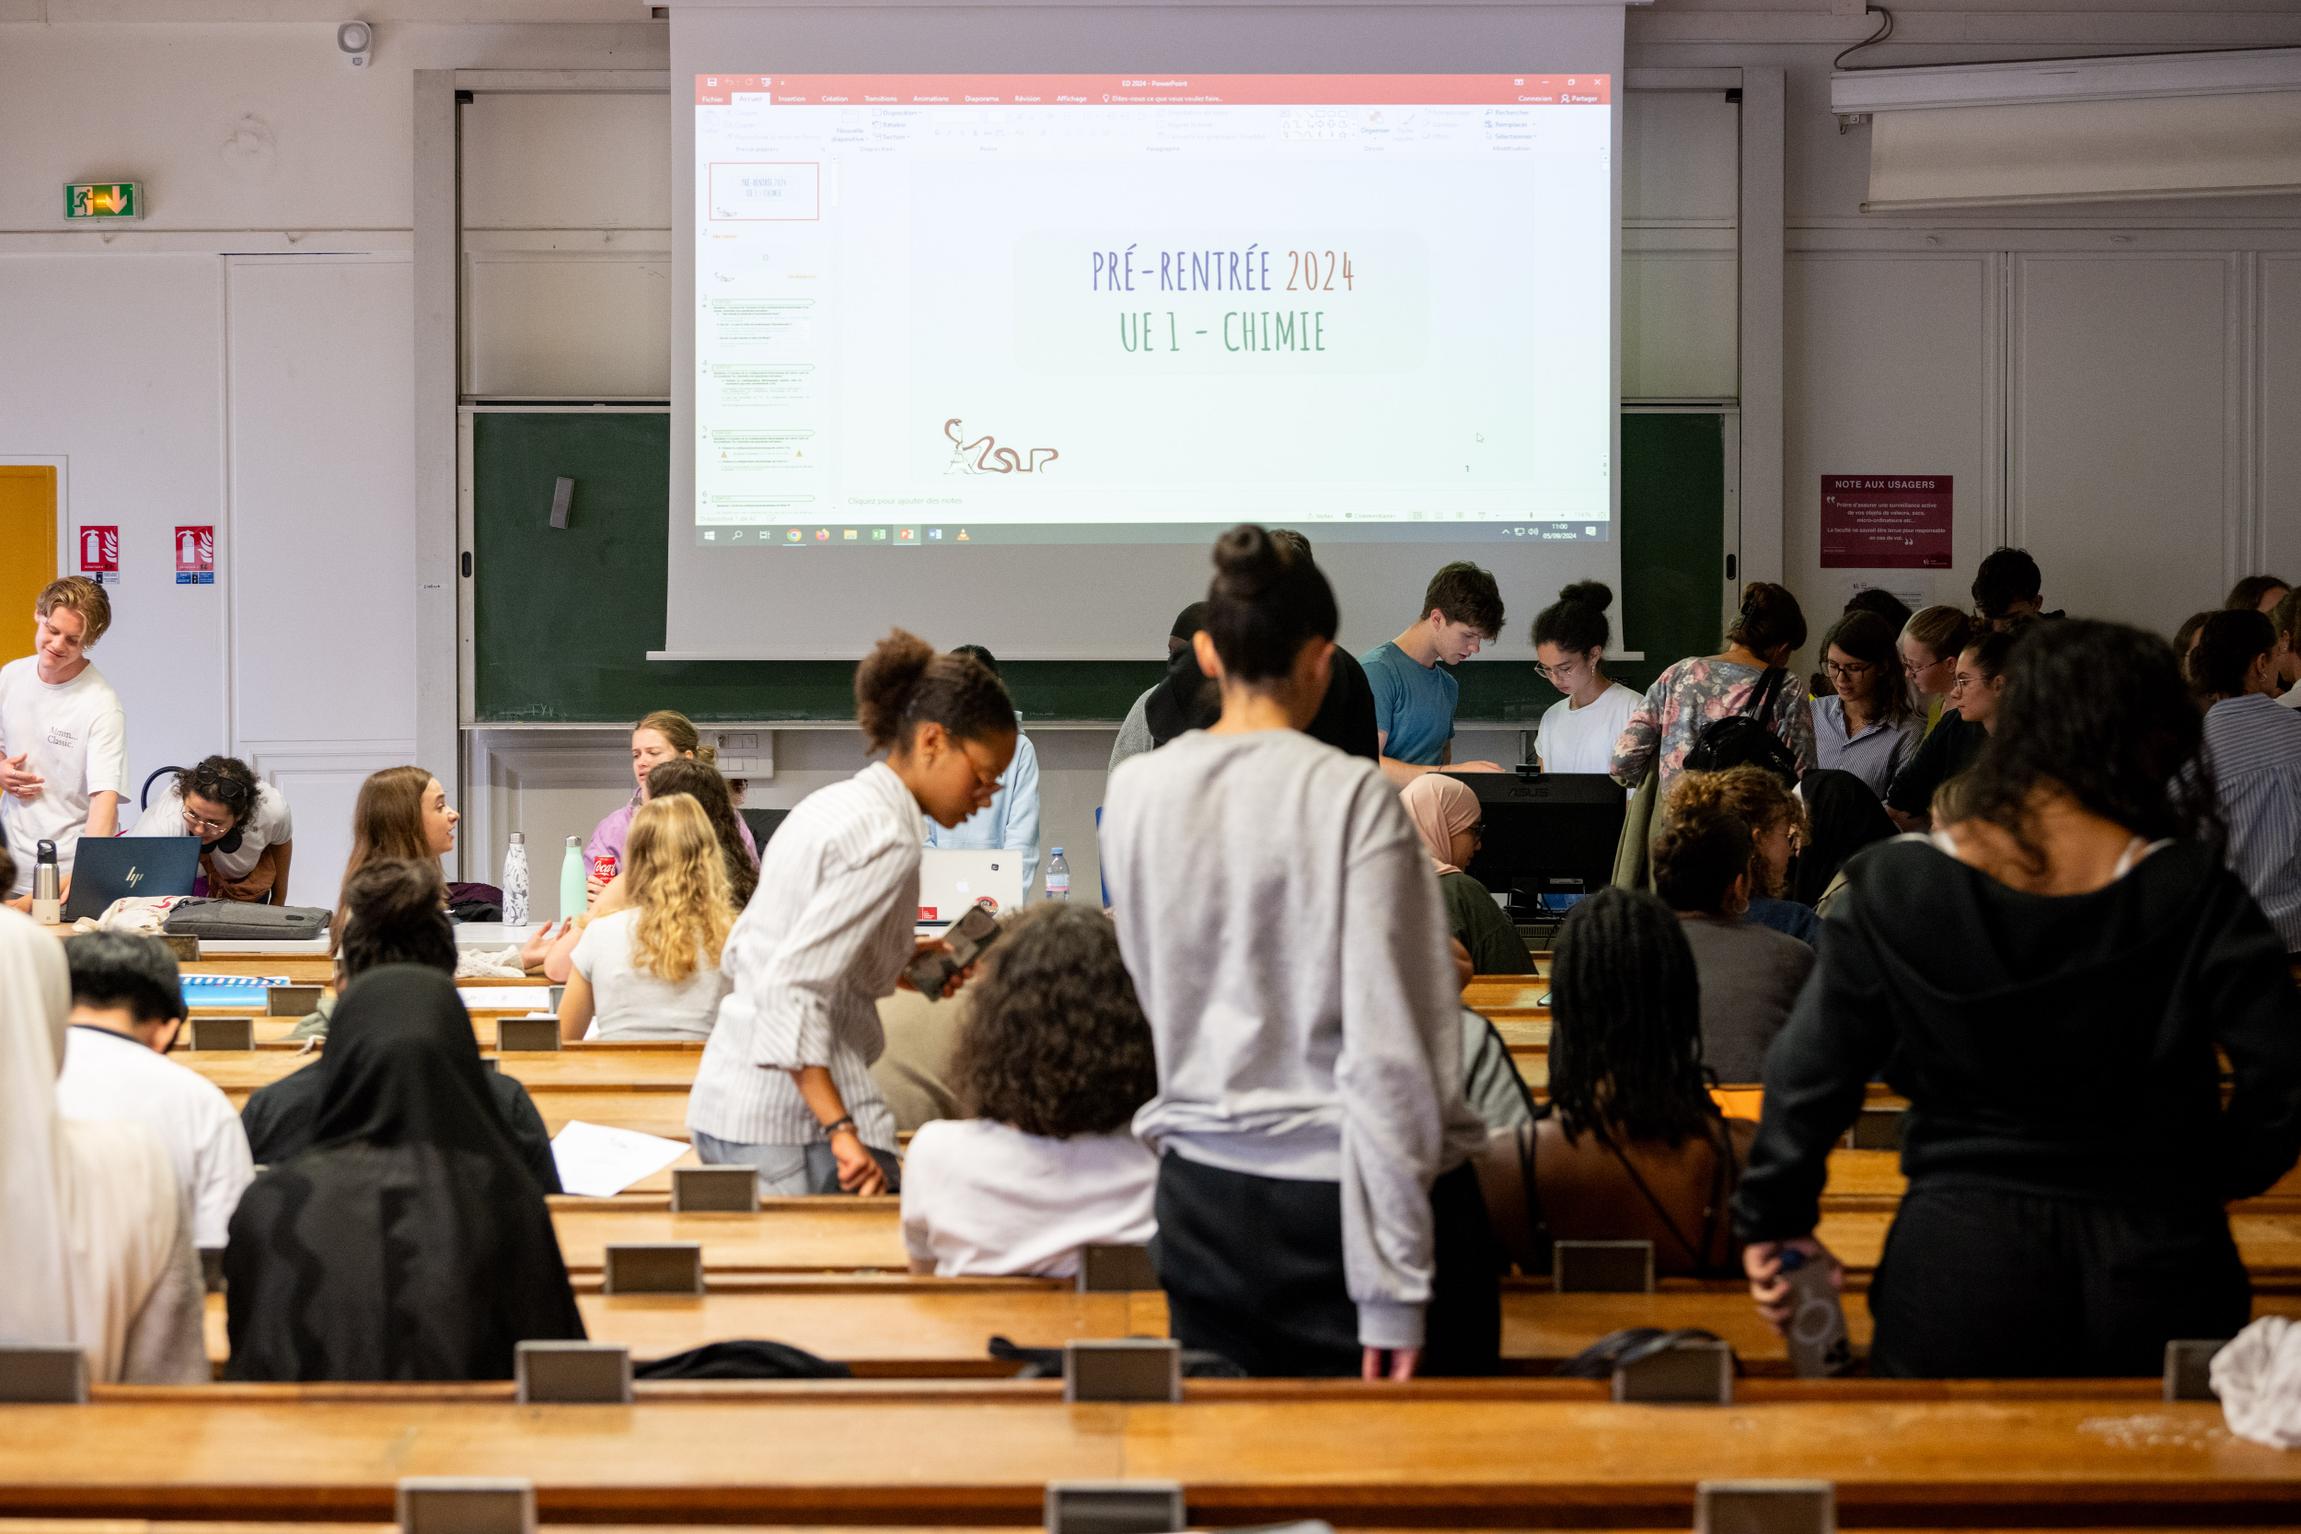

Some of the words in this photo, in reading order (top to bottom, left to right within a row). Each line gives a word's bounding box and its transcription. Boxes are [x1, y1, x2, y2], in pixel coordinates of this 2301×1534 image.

[822, 94, 849, 102] Création
[965, 95, 1000, 104] Diaporama
[1015, 94, 1041, 102] Révision
[1057, 95, 1088, 104] Affichage
[1572, 95, 1598, 104] Partager
[1093, 243, 1271, 292] PRÉ-RENTRÉE
[1286, 250, 1354, 292] 2024
[1120, 311, 1153, 352] UE
[1166, 311, 1179, 352] 1
[1224, 310, 1325, 352] CHIMIE
[1835, 480, 1862, 489] NOTE
[1864, 480, 1885, 489] AUX
[1887, 480, 1936, 489] USAGERS
[848, 497, 876, 506] Cliquez
[896, 497, 924, 506] ajouter
[926, 497, 940, 505] des
[941, 497, 962, 505] notes
[1552, 523, 1568, 531] 11:00
[1542, 532, 1577, 541] 05/09/2024
[1508, 787, 1549, 797] ASUS
[126, 865, 144, 888] hp
